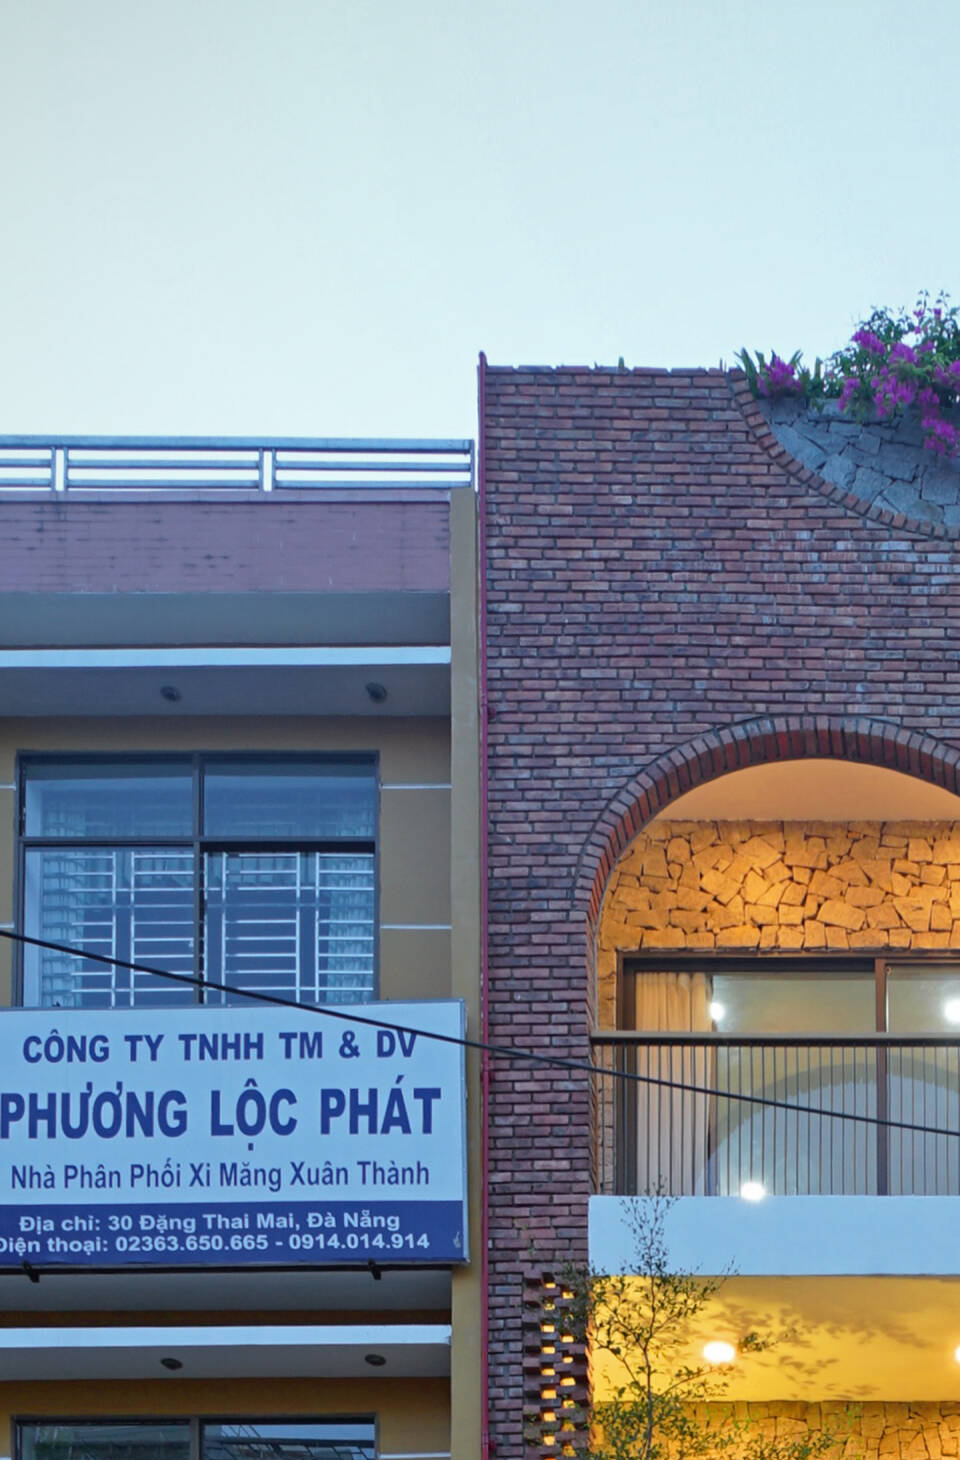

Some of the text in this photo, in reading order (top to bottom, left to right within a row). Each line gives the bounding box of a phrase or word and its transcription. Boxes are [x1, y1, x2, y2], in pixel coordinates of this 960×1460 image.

[23, 1029, 417, 1063] CÔNG TY TNHH TM & DV
[0, 1074, 441, 1151] PHƯƠNG LỘC PHÁT
[11, 1157, 430, 1193] Nhà Phân Phối Xi Măng Xuân Thành
[19, 1209, 401, 1235] Địa chỉ: 30 Đặng Thai Mai, Đà Nẵng
[47, 1236, 108, 1256] thoại:
[115, 1234, 269, 1252] 02363.650.665
[289, 1232, 430, 1250] 0914.014.914
